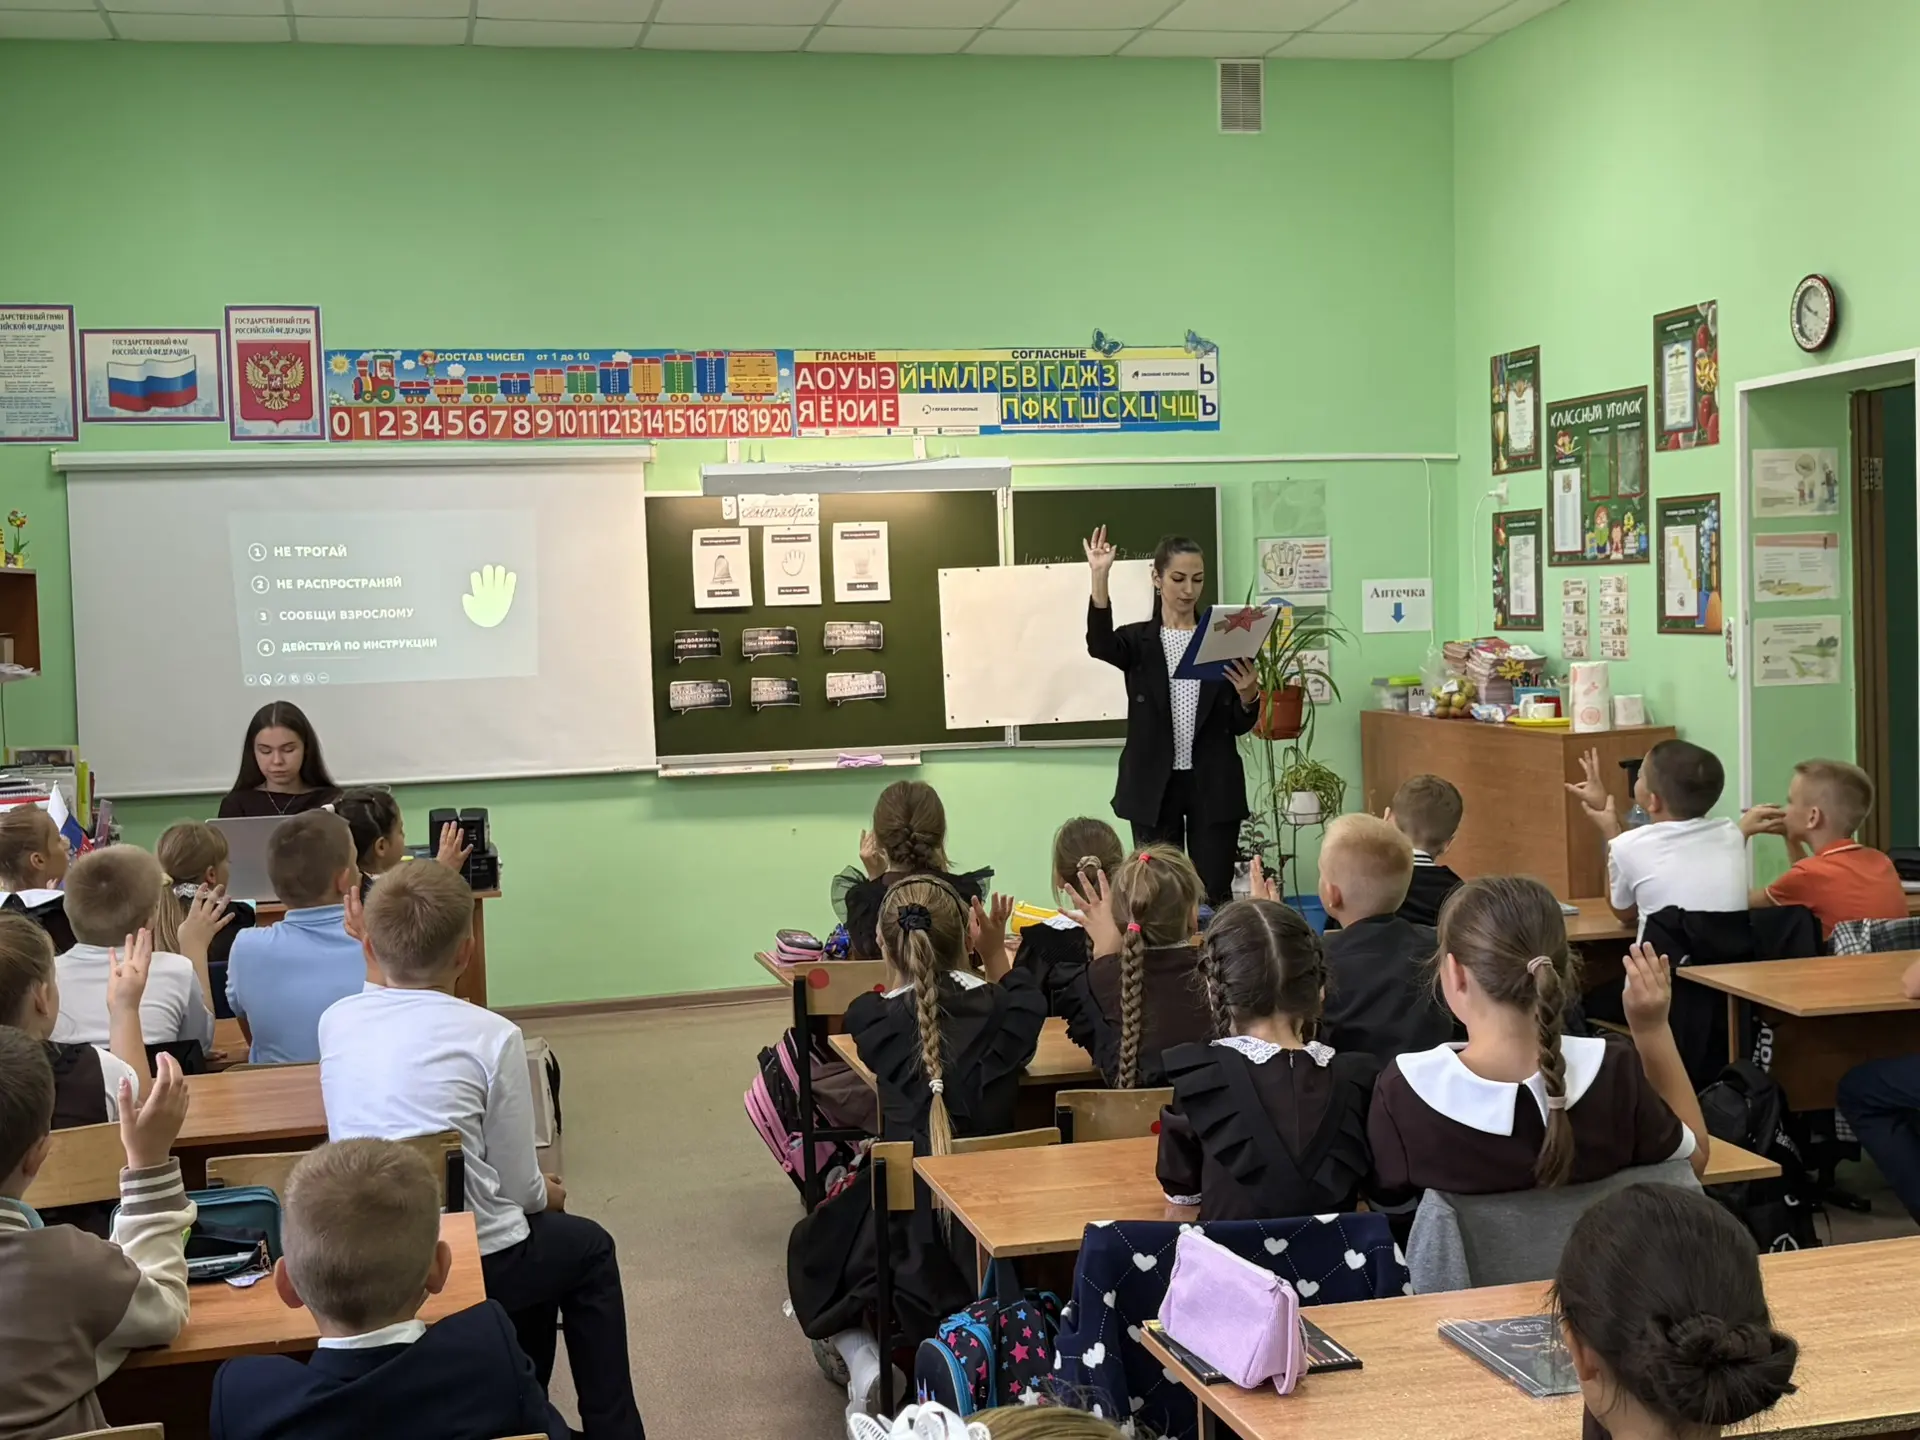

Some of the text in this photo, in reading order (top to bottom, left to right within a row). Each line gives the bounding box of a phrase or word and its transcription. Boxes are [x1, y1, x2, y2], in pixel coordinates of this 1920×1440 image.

[235, 325, 312, 336] РОССИЙСКОЙ ФЕДЕРАЦИИ
[438, 352, 484, 362] СОСТАВ
[486, 352, 525, 362] ЧИСЕЛ
[560, 354, 574, 362] до
[578, 352, 590, 360] 10
[815, 352, 876, 361] ГЛАСНЫЕ
[1011, 349, 1087, 359] СОГЛАСНЫЕ
[1550, 397, 1643, 427] КЛАССНЫЙ УГОЛОК
[332, 408, 791, 436] 0 1 2 3 4 5 6 7 8 9 10 11 12 13 14 15 16 17 18 19 20
[742, 504, 816, 524] сентября
[254, 544, 347, 557] 1 НЕ ТРОГАЙ
[257, 576, 402, 589] 2 НЕ РАСПРОСТРАНЯЙ
[1370, 587, 1426, 598] Аптечка
[260, 608, 414, 622] 3 СООБЩИ ВЗРОСЛОМУ
[282, 640, 341, 653] ДЕЙСТВУЙ
[344, 641, 360, 650] ПО
[363, 638, 438, 650] ИНСТРУКЦИИ
